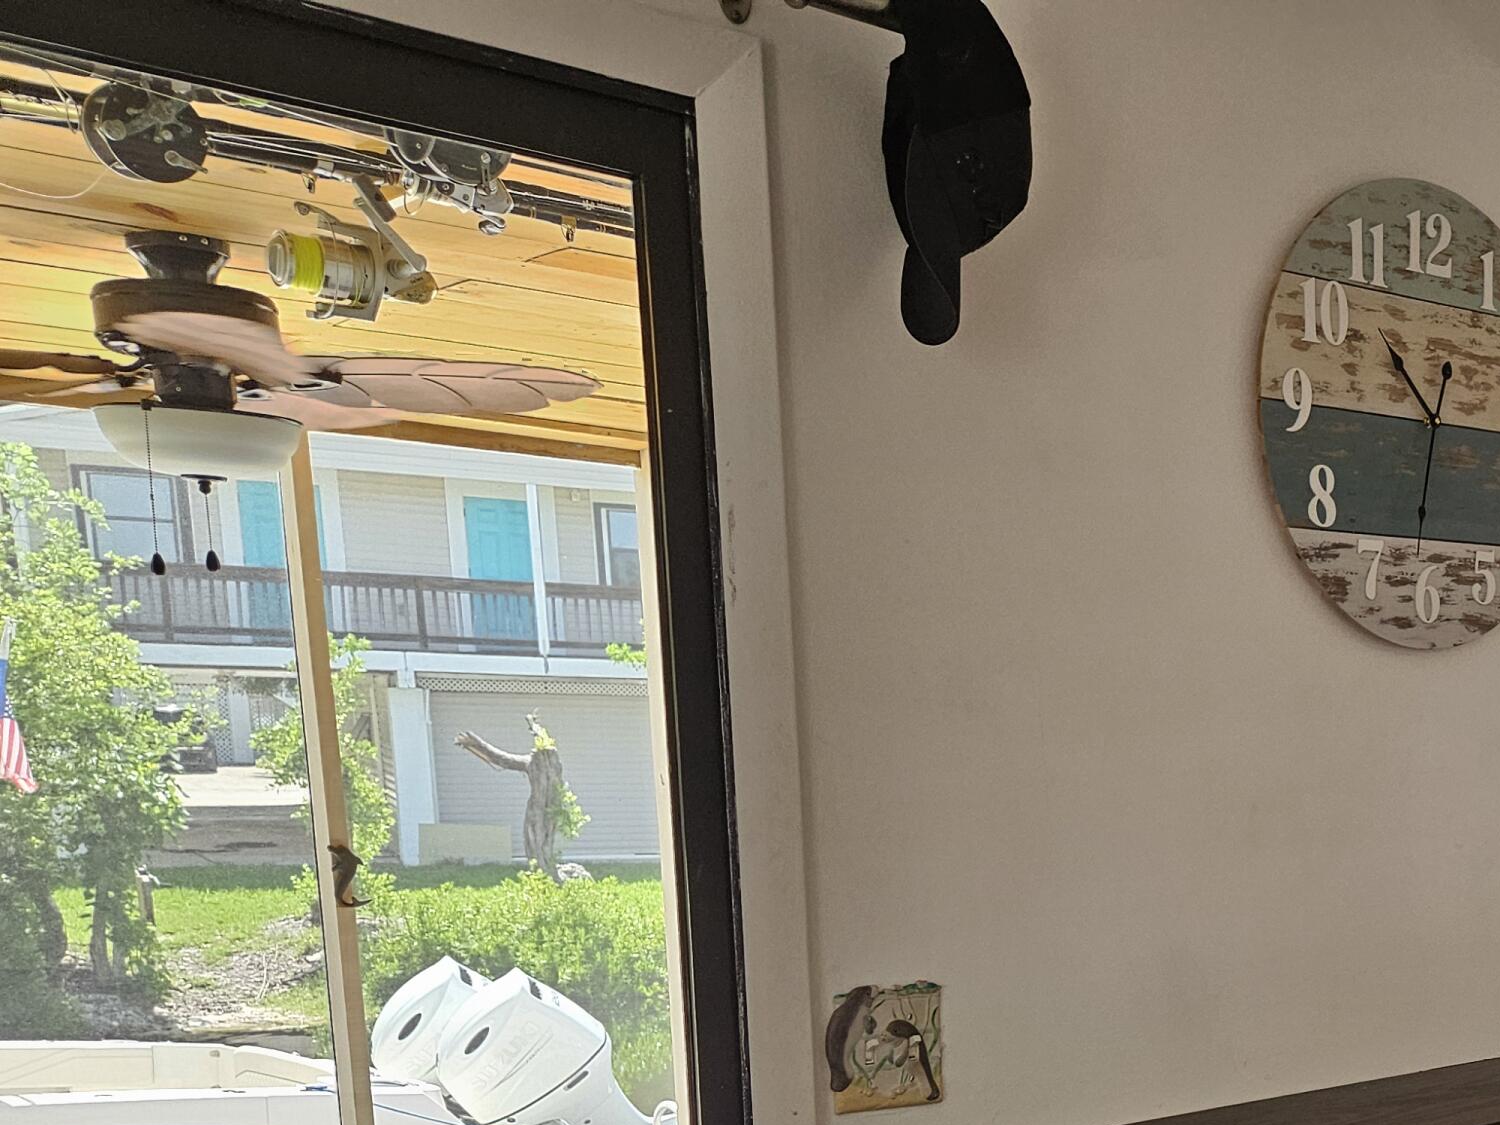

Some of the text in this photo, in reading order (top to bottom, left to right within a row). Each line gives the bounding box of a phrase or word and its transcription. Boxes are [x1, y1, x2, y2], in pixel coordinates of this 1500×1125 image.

[1347, 217, 1388, 288] 11
[1406, 210, 1452, 278] 12
[1300, 277, 1348, 346] 10
[1479, 251, 1497, 312] 1
[1282, 367, 1313, 432] 9
[1307, 464, 1337, 528] 8
[1357, 538, 1385, 600] 7
[1415, 564, 1441, 624] 6
[1472, 550, 1497, 605] 5
